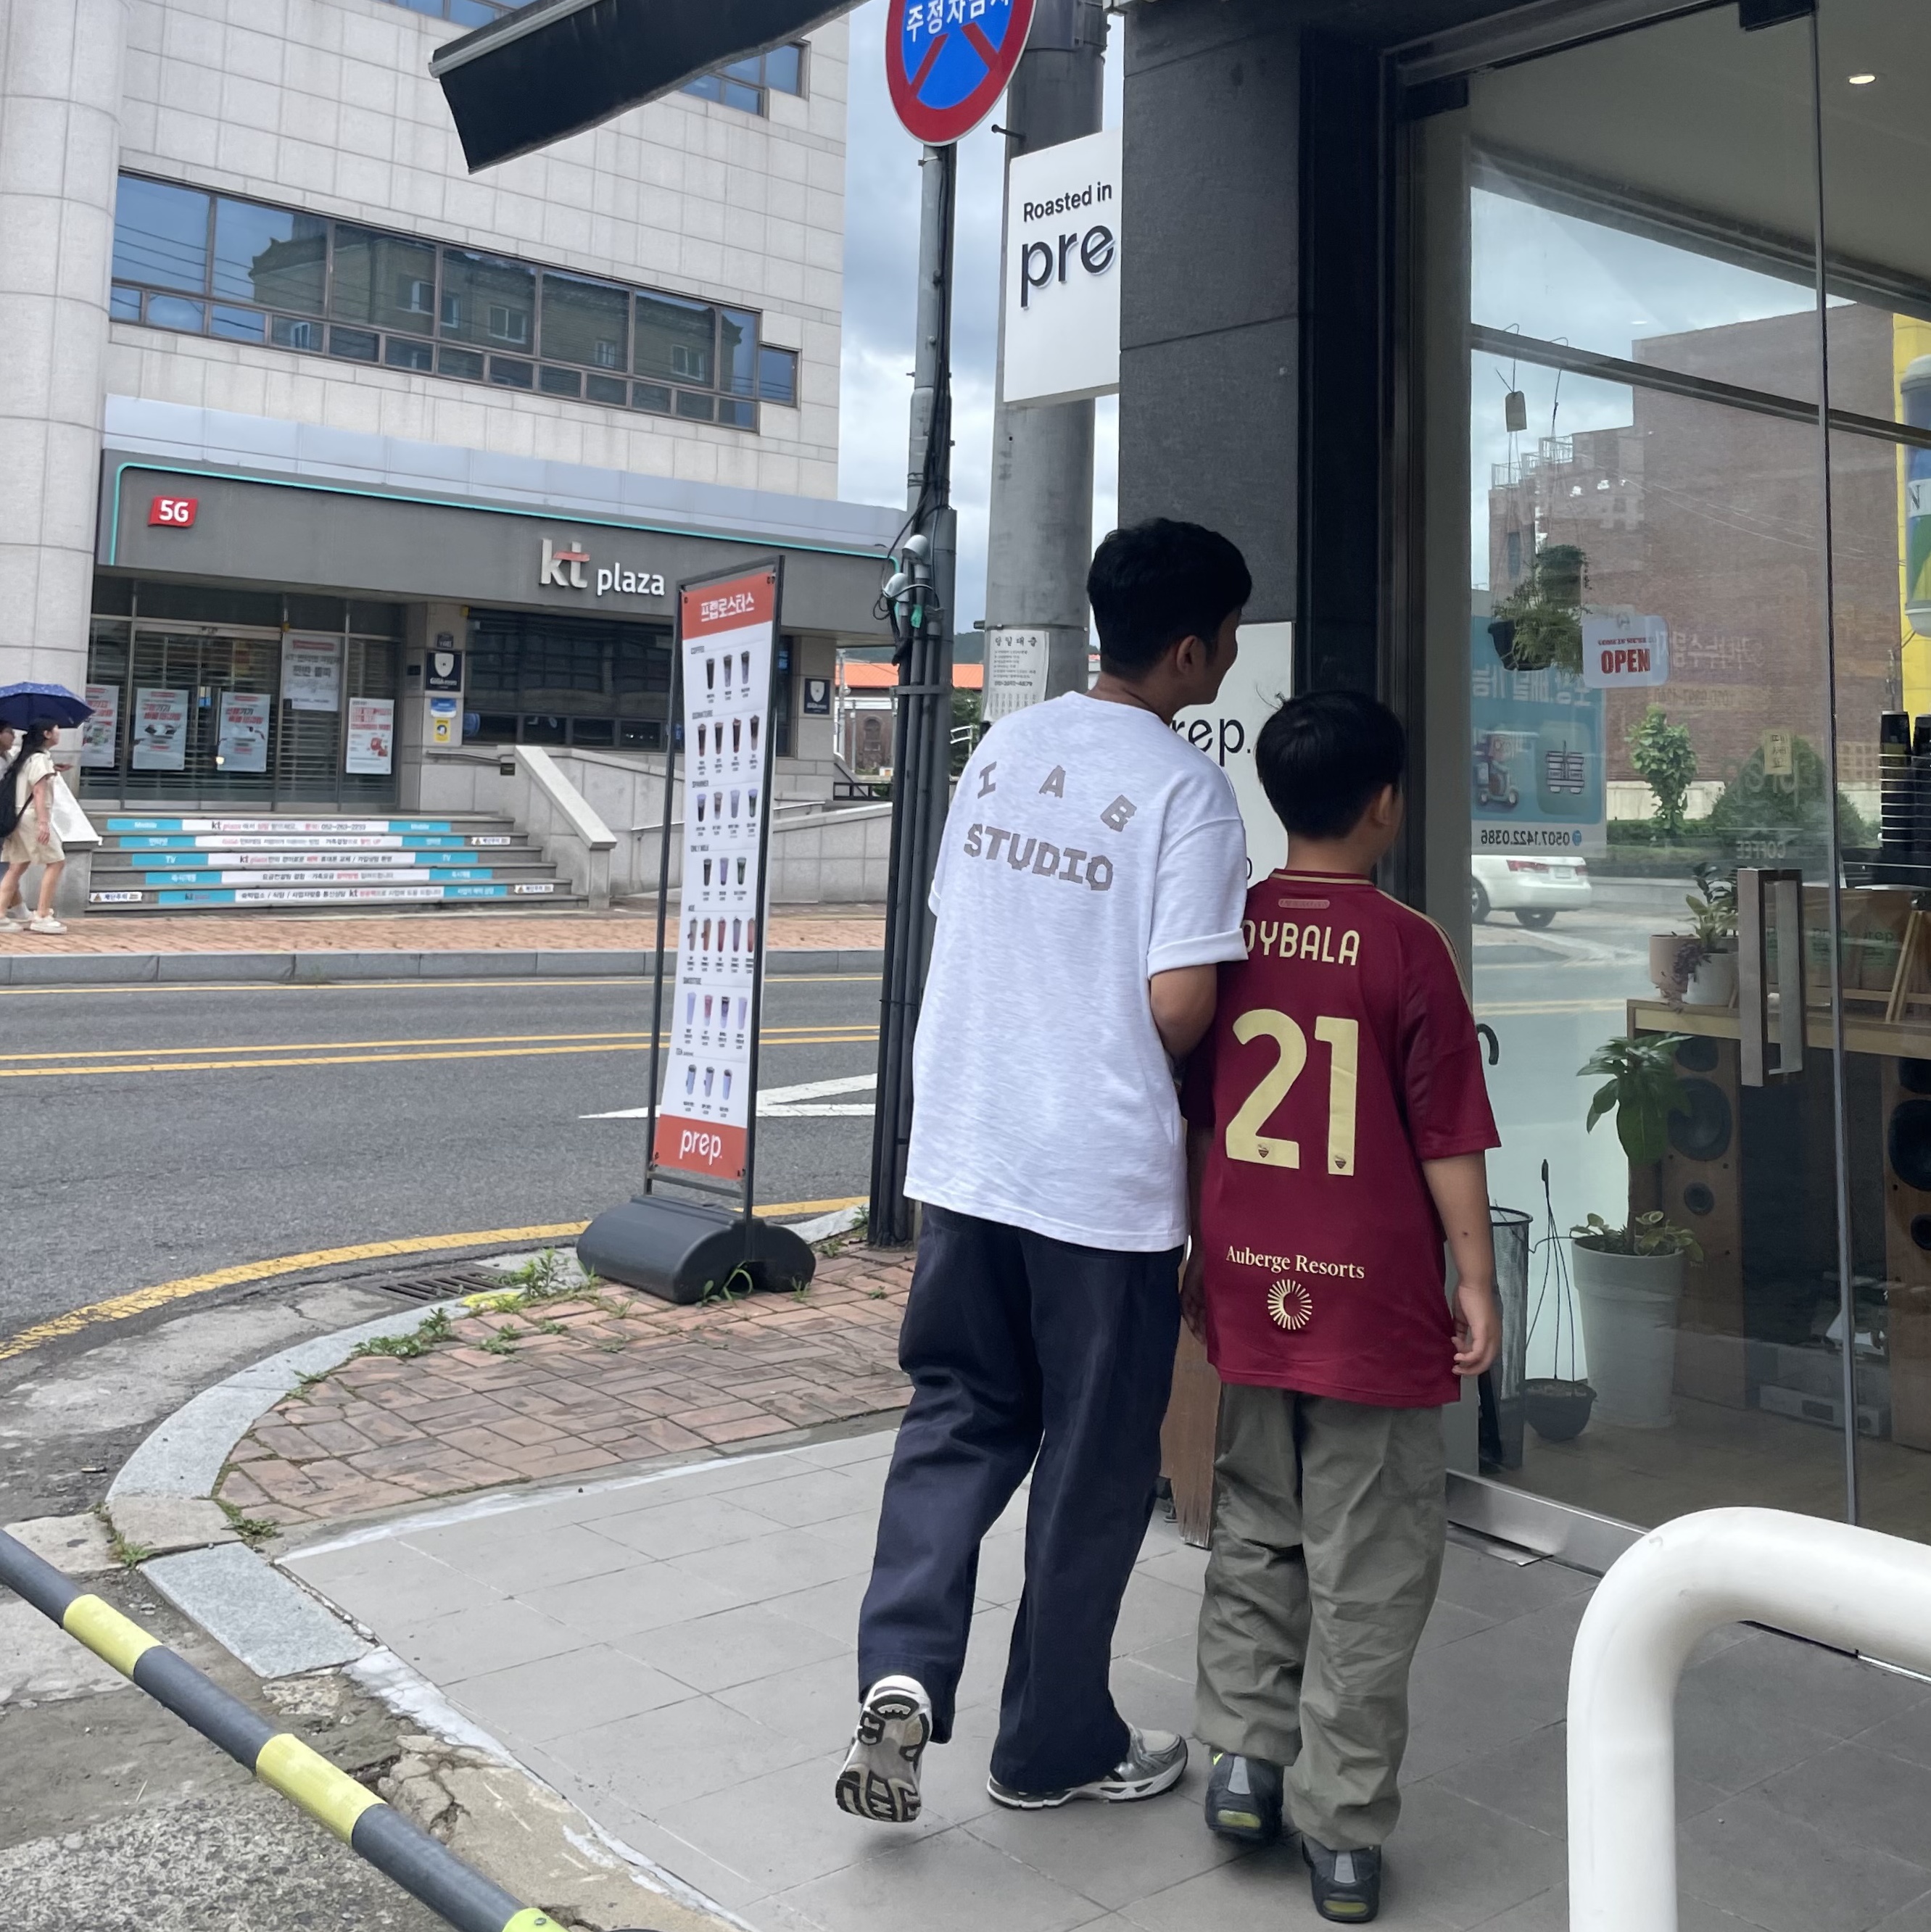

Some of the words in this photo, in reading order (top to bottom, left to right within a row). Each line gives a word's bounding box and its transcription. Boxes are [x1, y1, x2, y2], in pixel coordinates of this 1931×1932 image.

[1022, 186, 1092, 223] Roasted
[1096, 182, 1112, 204] in
[159, 499, 189, 523] 5G
[539, 538, 590, 589] kt
[597, 562, 665, 597] plaza
[1601, 648, 1651, 674] OPEN
[165, 855, 177, 863] TV
[964, 823, 1115, 892] STUDIO
[1225, 1008, 1360, 1177] 21
[1225, 1245, 1291, 1274] Auberge
[1294, 1254, 1365, 1280] Resorts
